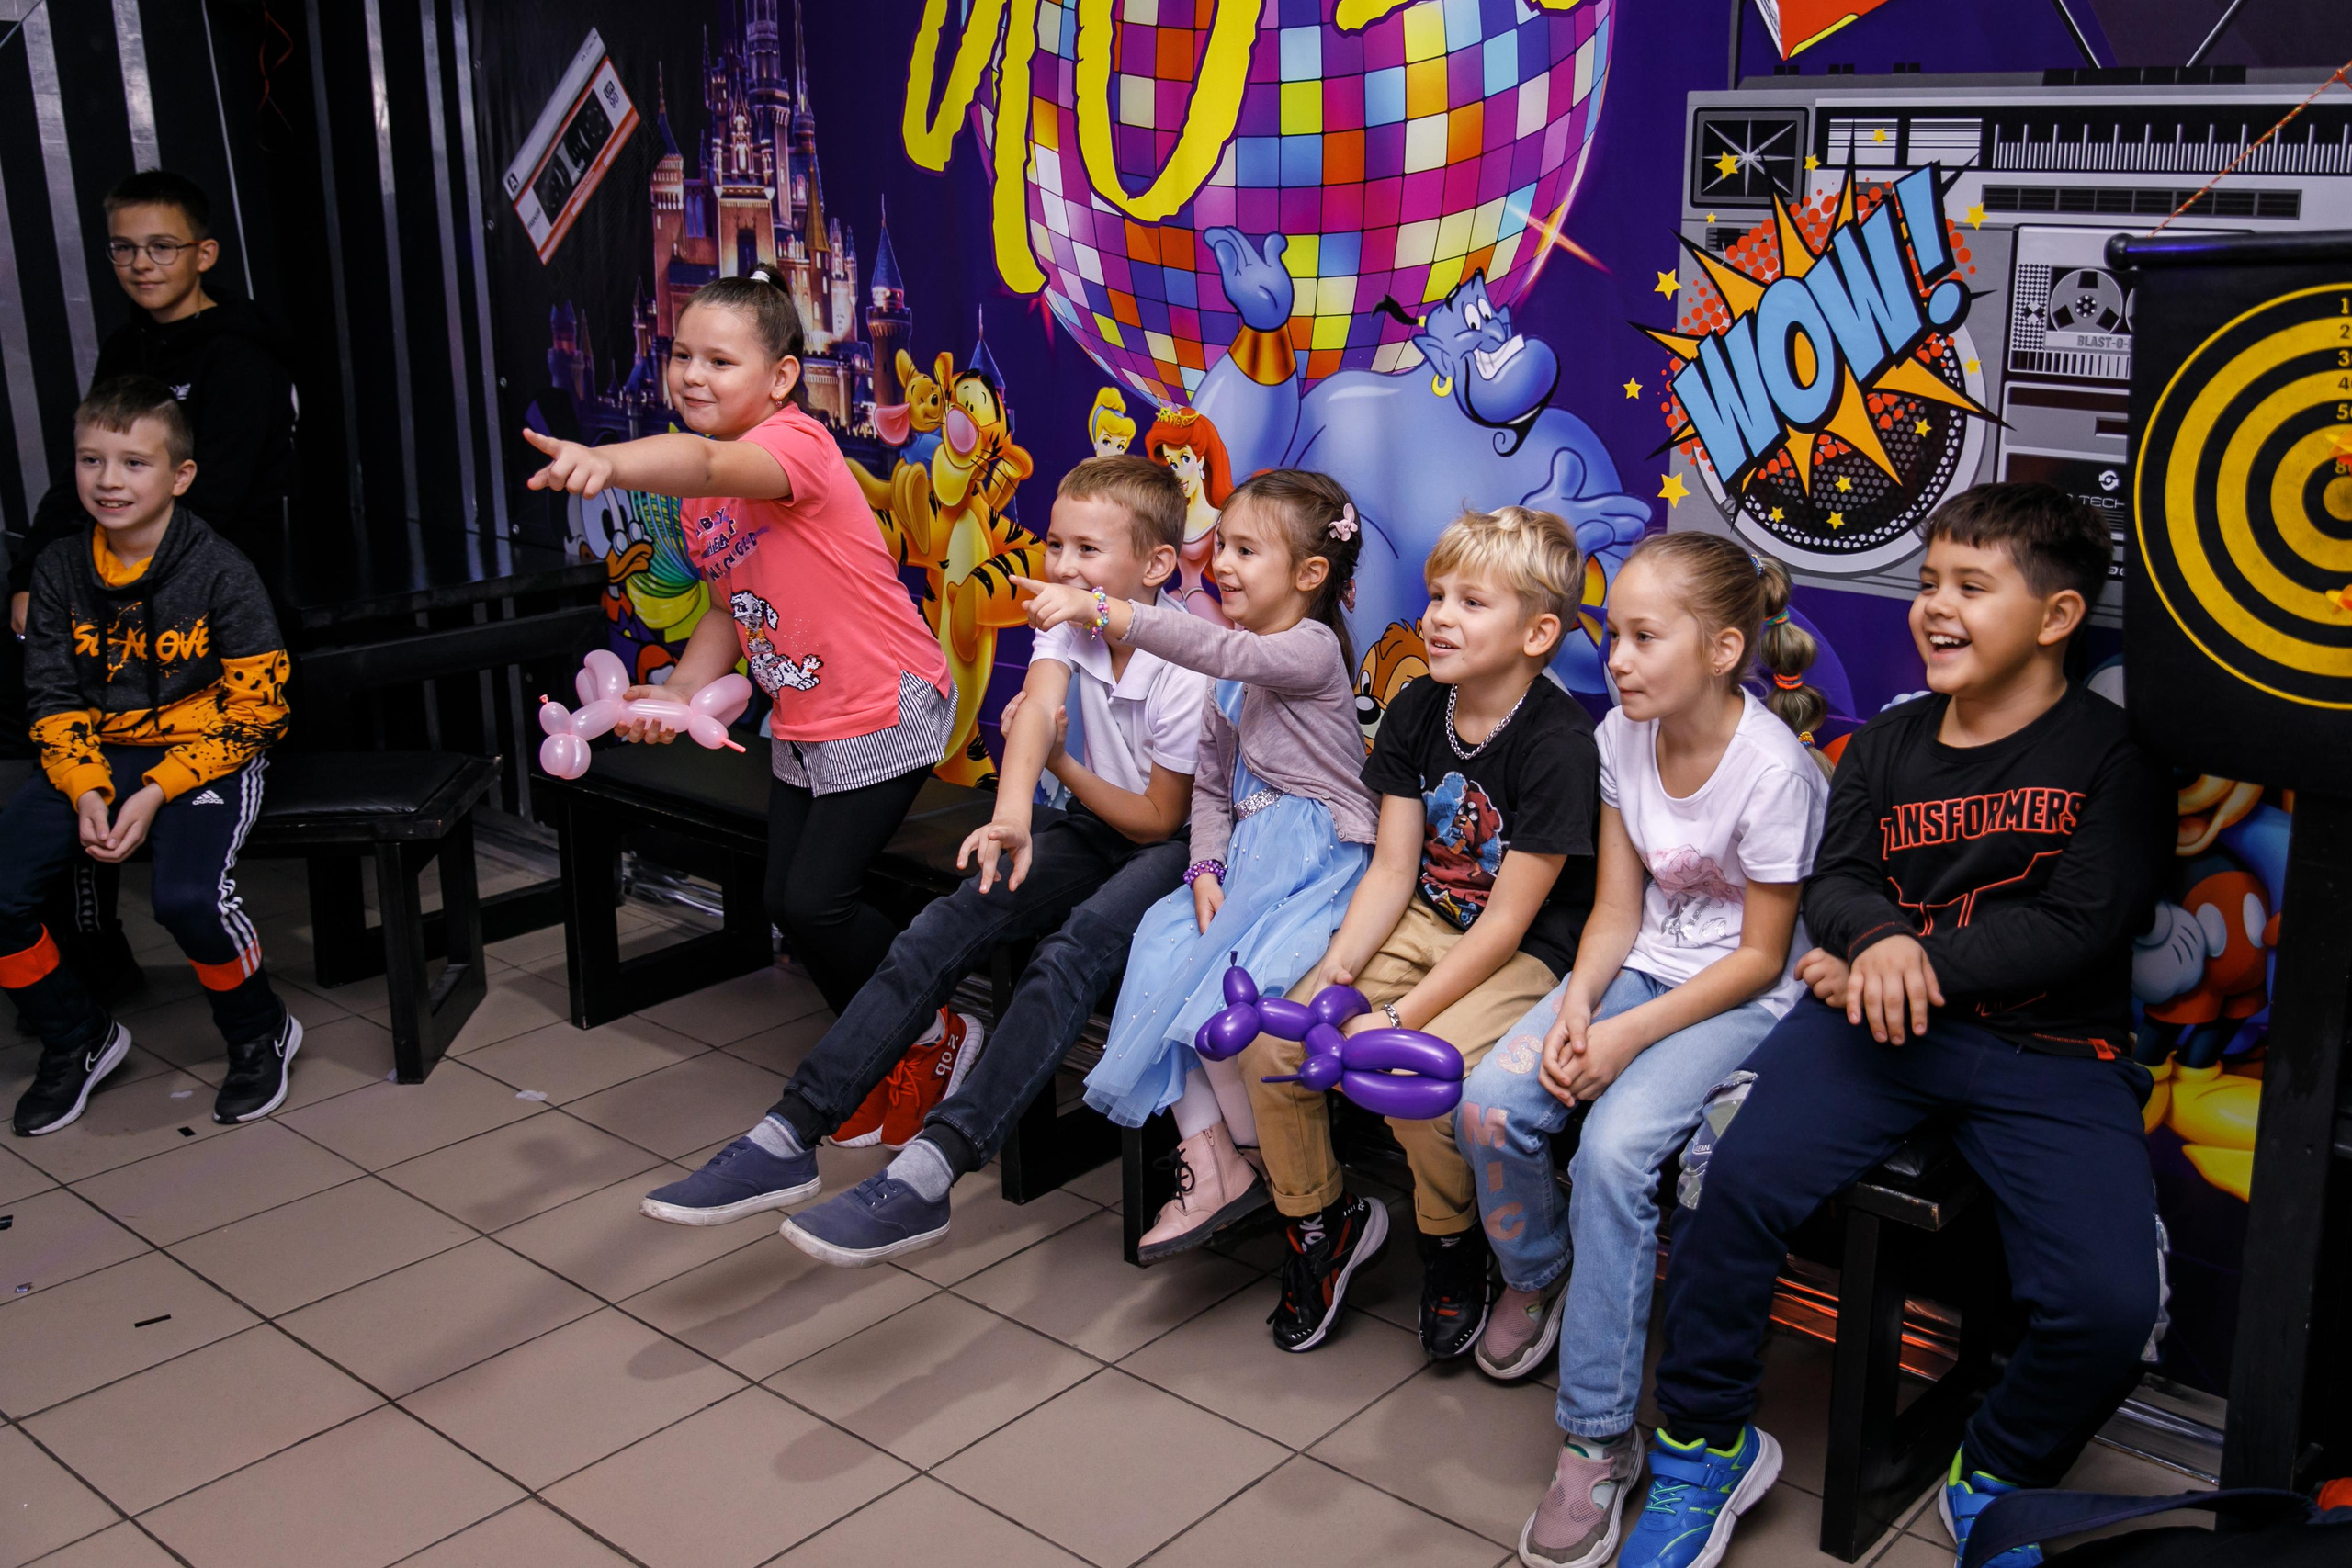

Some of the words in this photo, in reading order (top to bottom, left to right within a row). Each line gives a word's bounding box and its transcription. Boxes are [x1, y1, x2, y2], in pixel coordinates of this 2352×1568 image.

[1670, 161, 1964, 487] WOW!
[2077, 334, 2131, 349] BLAST-O-
[2338, 350, 2352, 367] 3
[2337, 377, 2352, 391] 4
[2336, 403, 2352, 420] 5
[1299, 1214, 1326, 1252] OK
